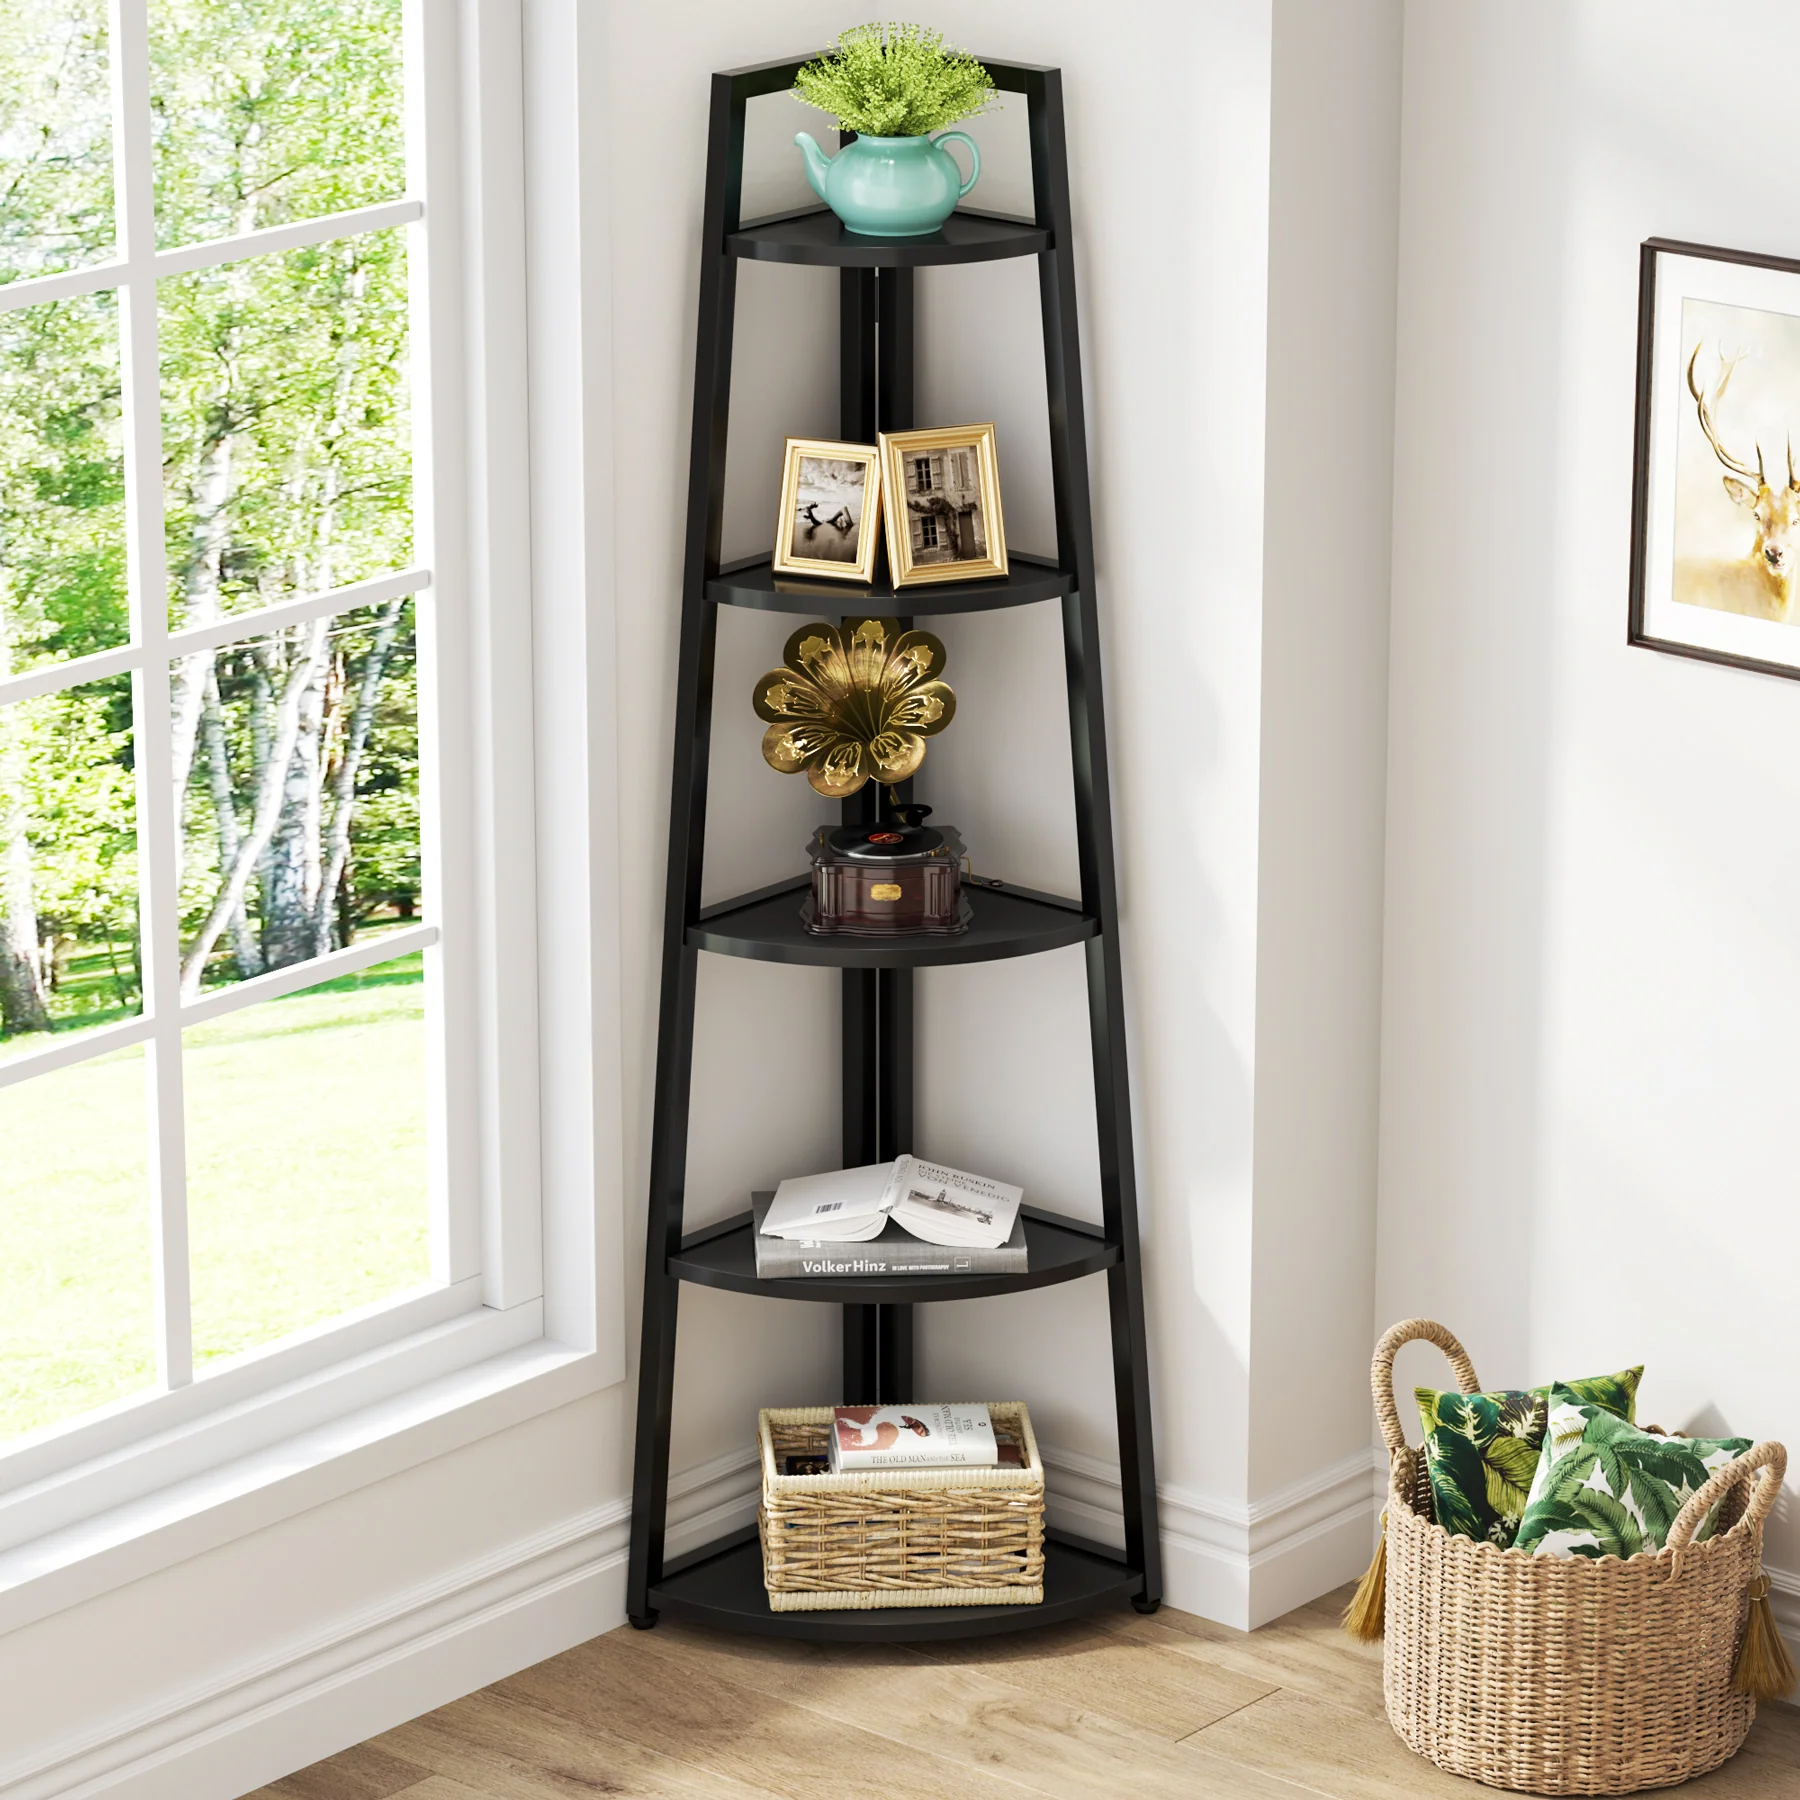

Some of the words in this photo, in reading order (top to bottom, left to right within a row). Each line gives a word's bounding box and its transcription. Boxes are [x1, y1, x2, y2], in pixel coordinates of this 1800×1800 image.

[918, 1164, 949, 1177] JOHN
[918, 1172, 948, 1184] VON
[802, 1260, 851, 1273] Volker
[853, 1259, 887, 1272] Hinz
[871, 1455, 888, 1464] THE
[889, 1455, 907, 1464] OLD
[908, 1454, 927, 1463] MAN
[950, 1453, 966, 1462] SEA
